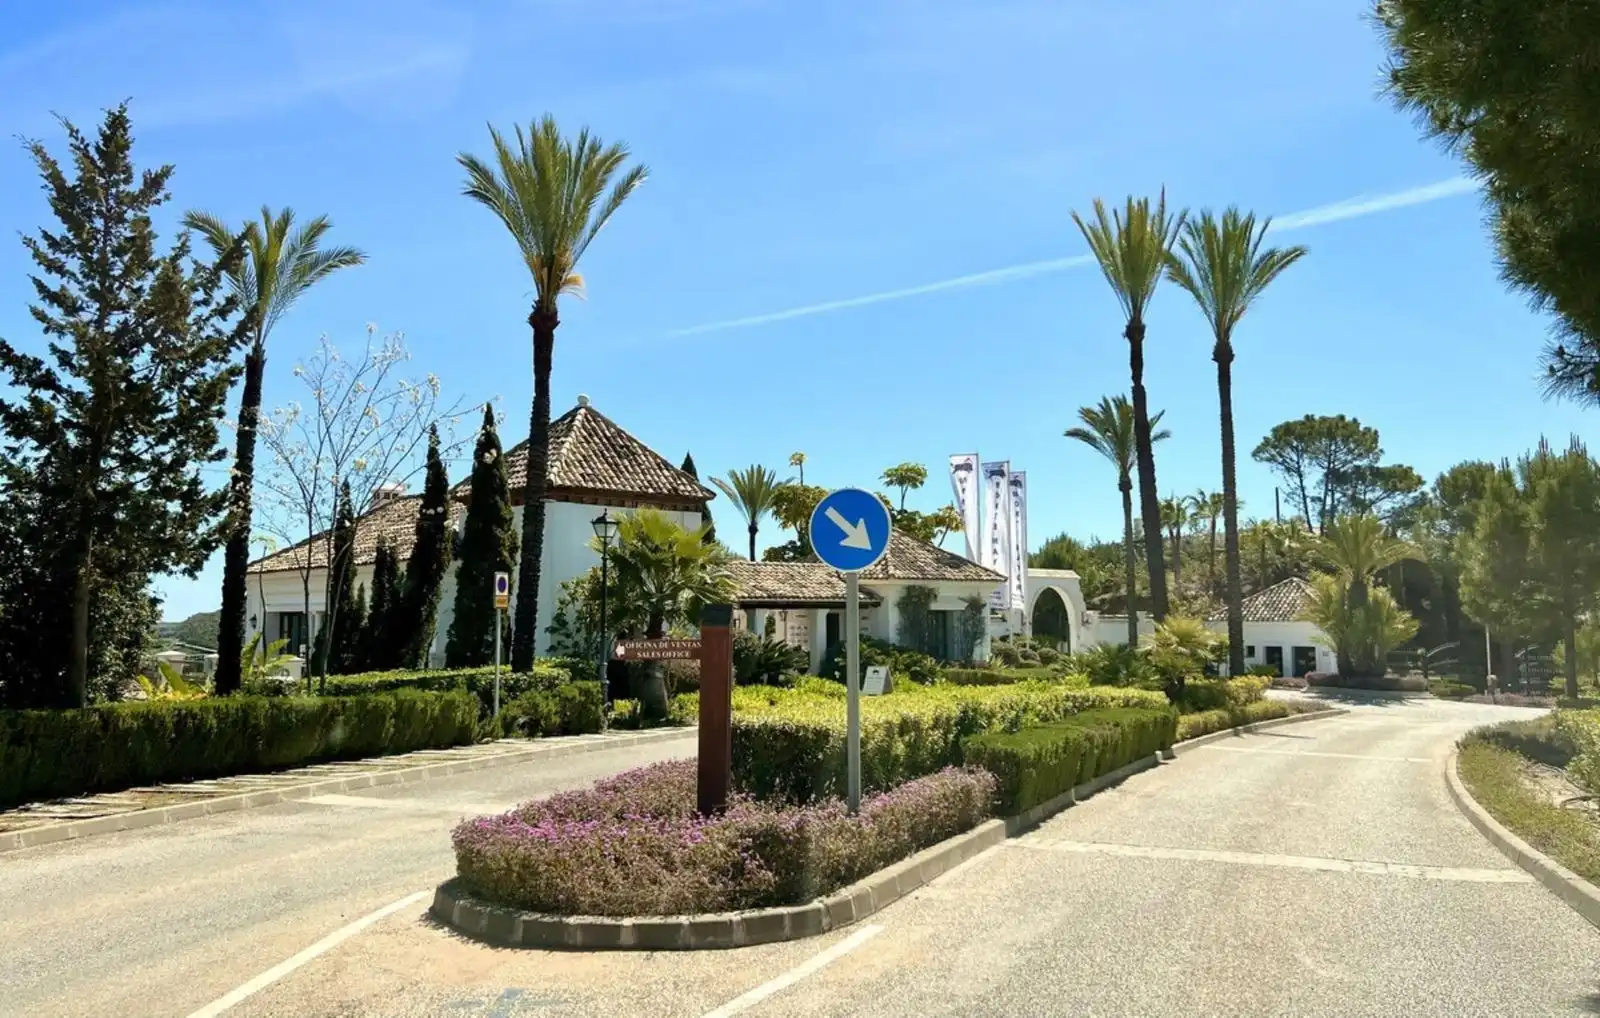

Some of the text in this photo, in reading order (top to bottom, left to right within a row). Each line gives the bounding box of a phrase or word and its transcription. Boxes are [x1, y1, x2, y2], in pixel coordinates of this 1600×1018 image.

[625, 641, 657, 649] OFICINA
[659, 641, 668, 649] DE
[662, 651, 690, 659] OFFICE
